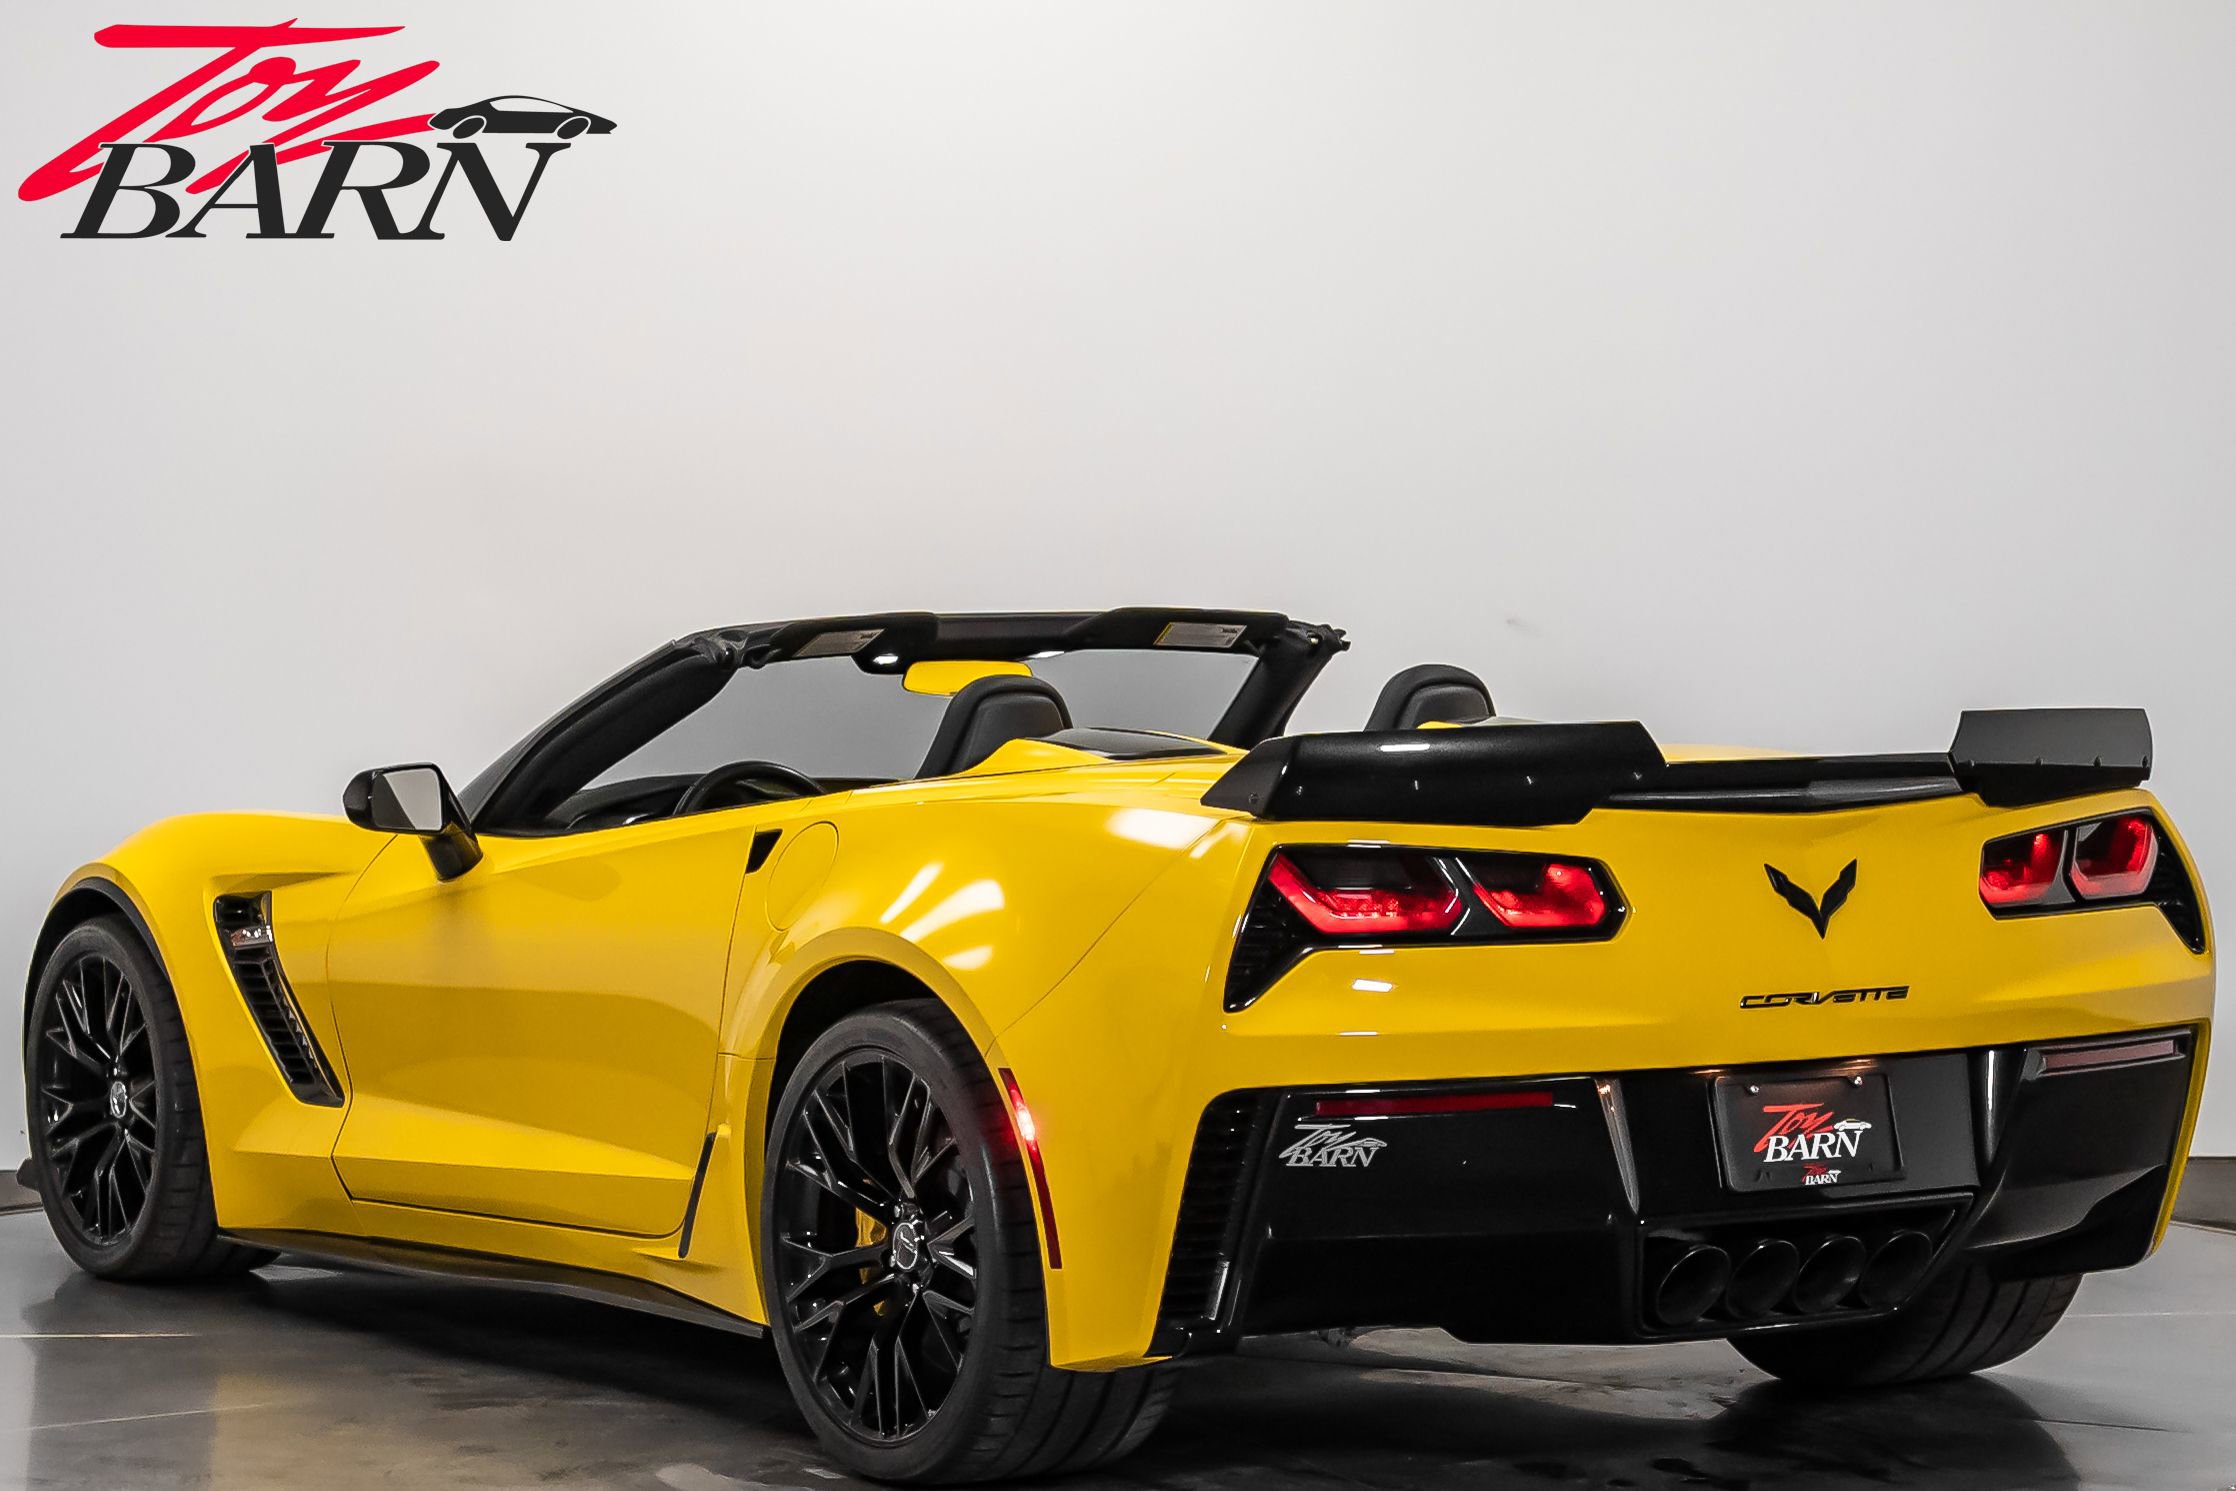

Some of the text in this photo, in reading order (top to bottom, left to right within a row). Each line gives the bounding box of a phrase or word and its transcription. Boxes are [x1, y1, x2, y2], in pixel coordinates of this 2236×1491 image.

[1740, 985, 1910, 1009] CORVETTE
[1753, 1102, 1834, 1153] Toy
[1286, 1147, 1380, 1167] BARN
[1763, 1130, 1863, 1162] BARN
[1805, 1172, 1840, 1186] BARN
